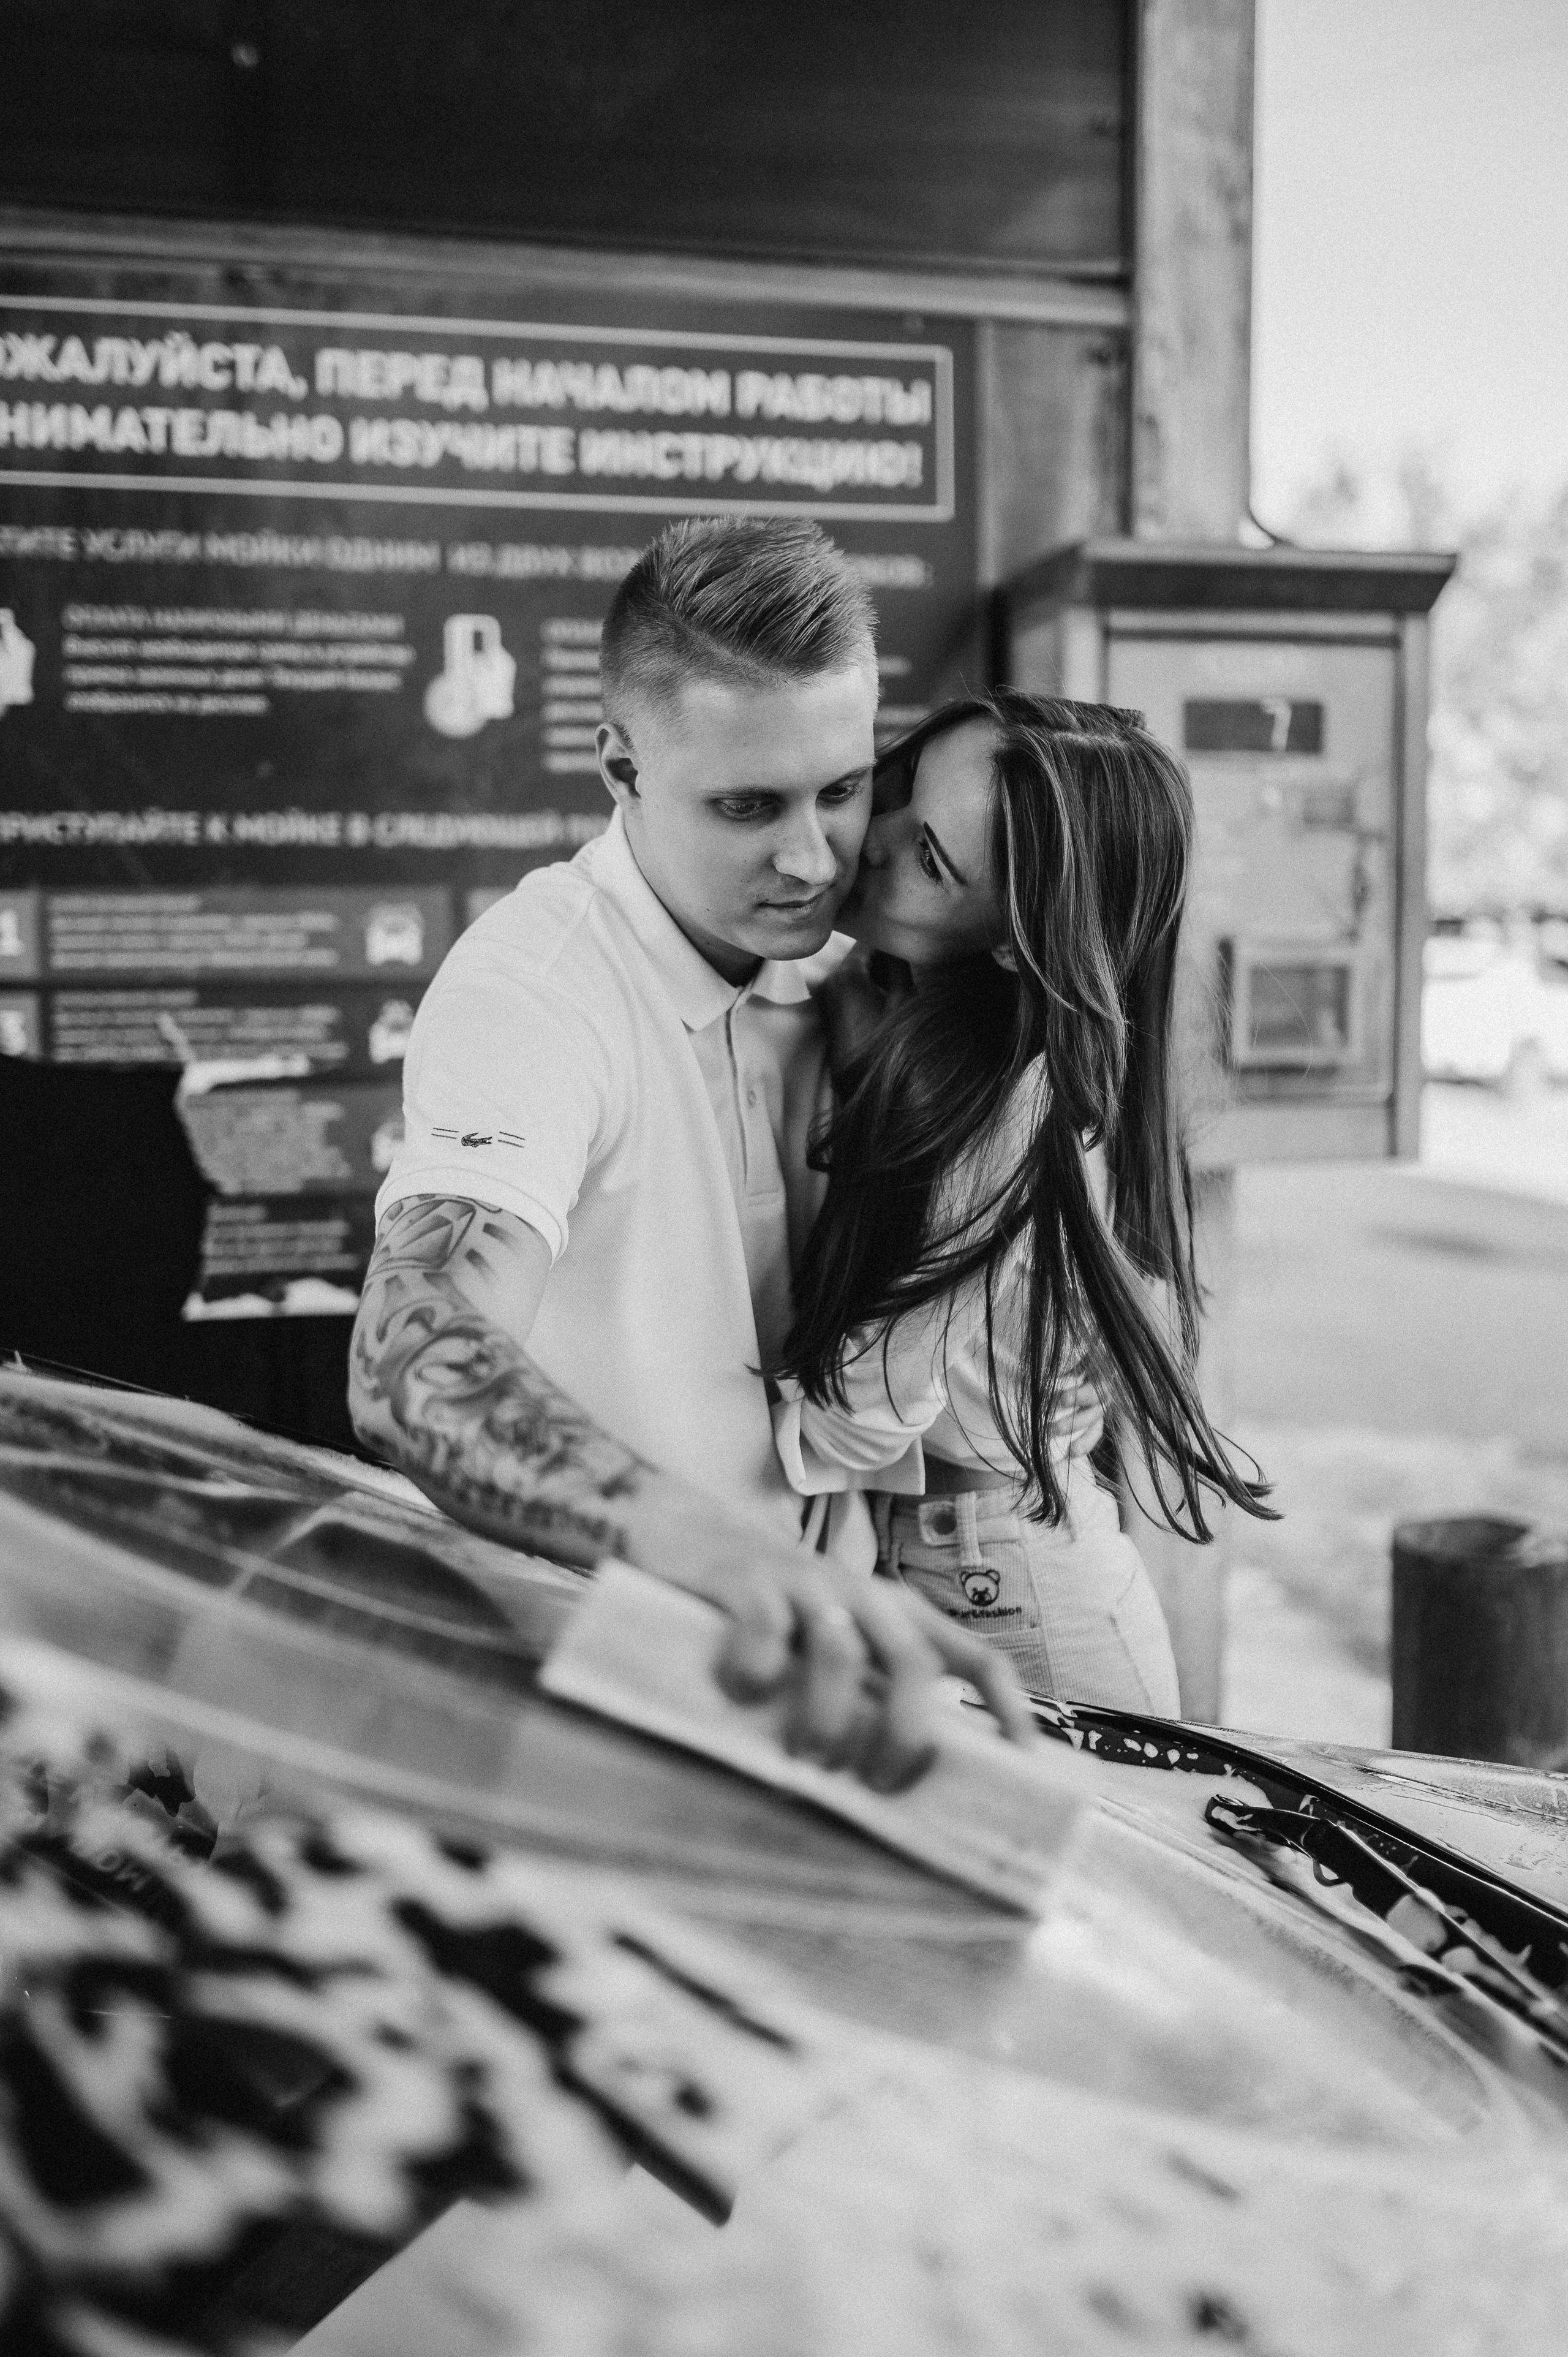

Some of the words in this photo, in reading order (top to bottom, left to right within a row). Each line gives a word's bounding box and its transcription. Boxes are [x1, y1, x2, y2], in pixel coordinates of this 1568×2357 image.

[315, 347, 489, 413] ПЕРЕД
[491, 357, 731, 417] НАЧАЛОМ
[736, 370, 932, 426] РАБОТЫ
[350, 416, 576, 475] ИЗУЧИТЕ
[579, 427, 924, 491] ИНСТРУКЦИЮ!
